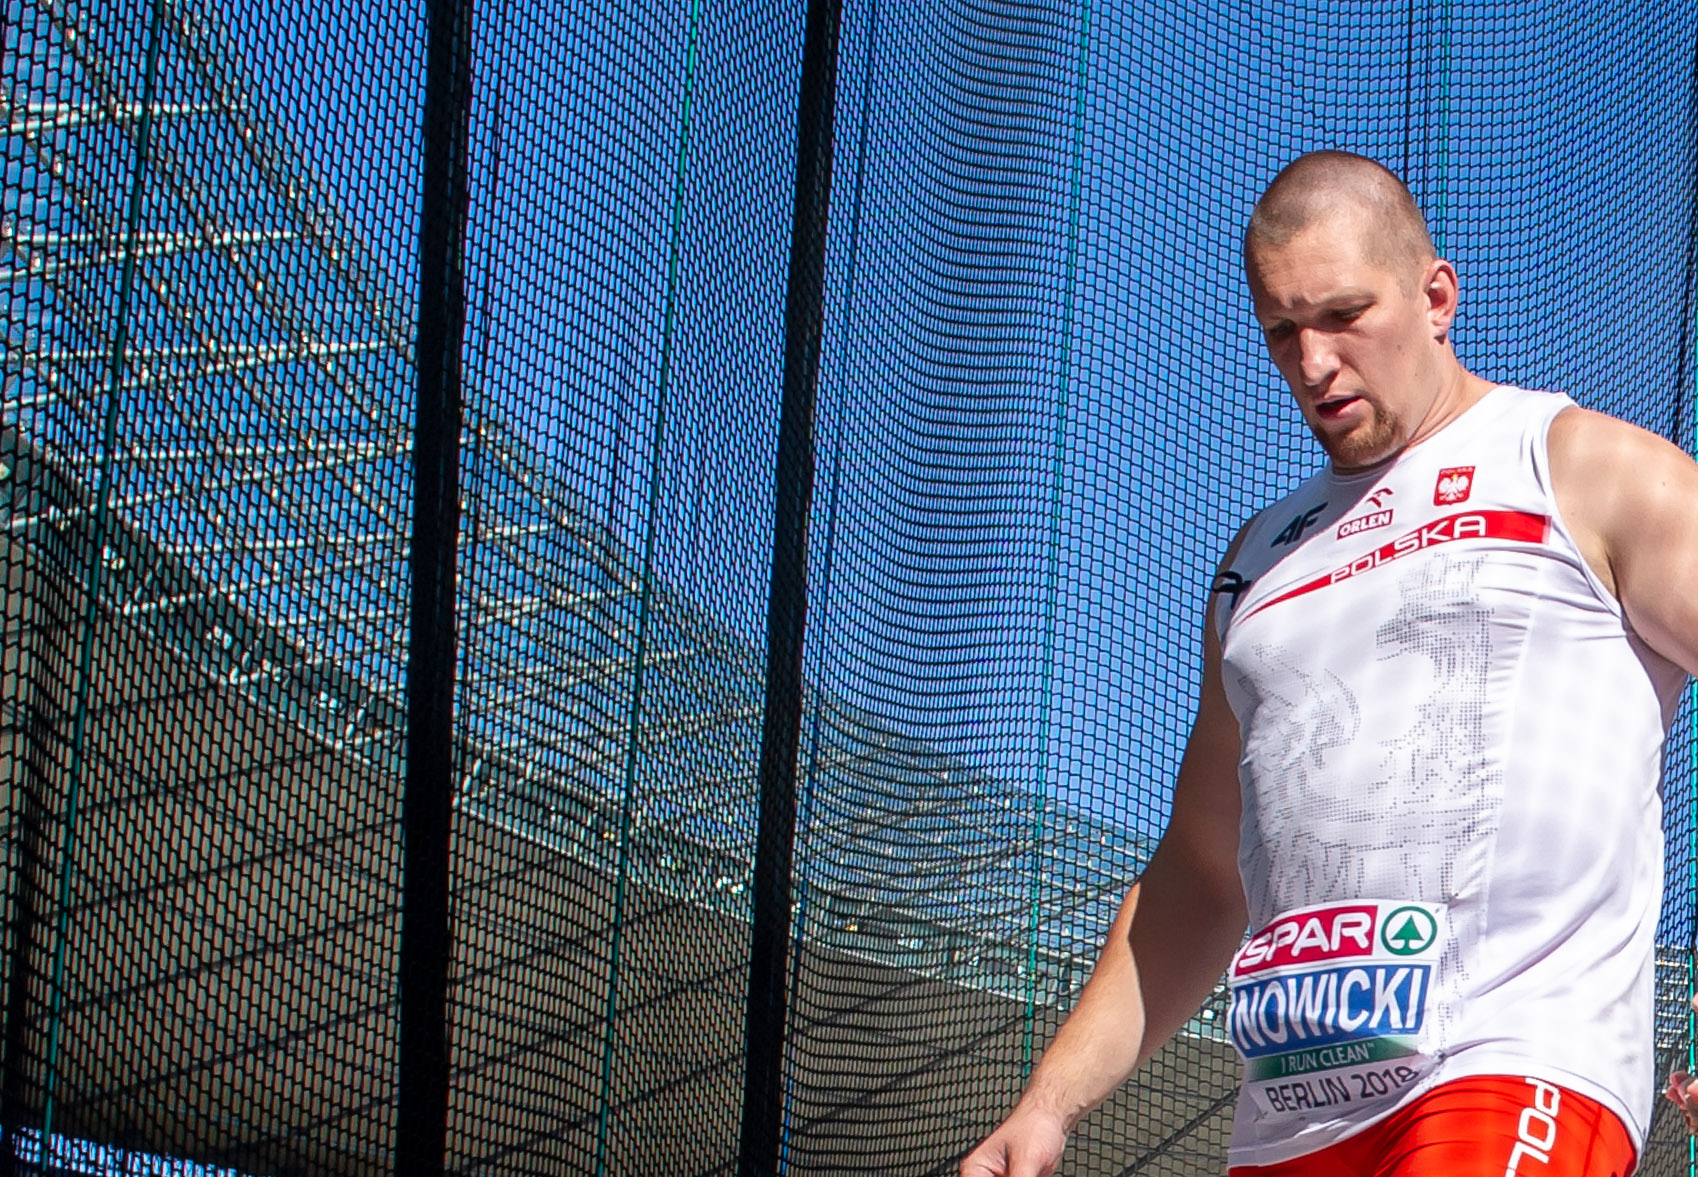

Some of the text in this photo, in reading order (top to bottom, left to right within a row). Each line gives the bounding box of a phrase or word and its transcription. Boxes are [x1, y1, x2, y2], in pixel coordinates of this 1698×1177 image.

[1339, 511, 1391, 537] ORLEN
[1329, 515, 1487, 585] POLSKA
[1238, 912, 1372, 968] SPAR
[1235, 968, 1424, 1050] NOWICKI
[1265, 1065, 1420, 1112] BERLIN 2018
[1281, 1057, 1286, 1073] I
[1288, 1053, 1317, 1072] RUN
